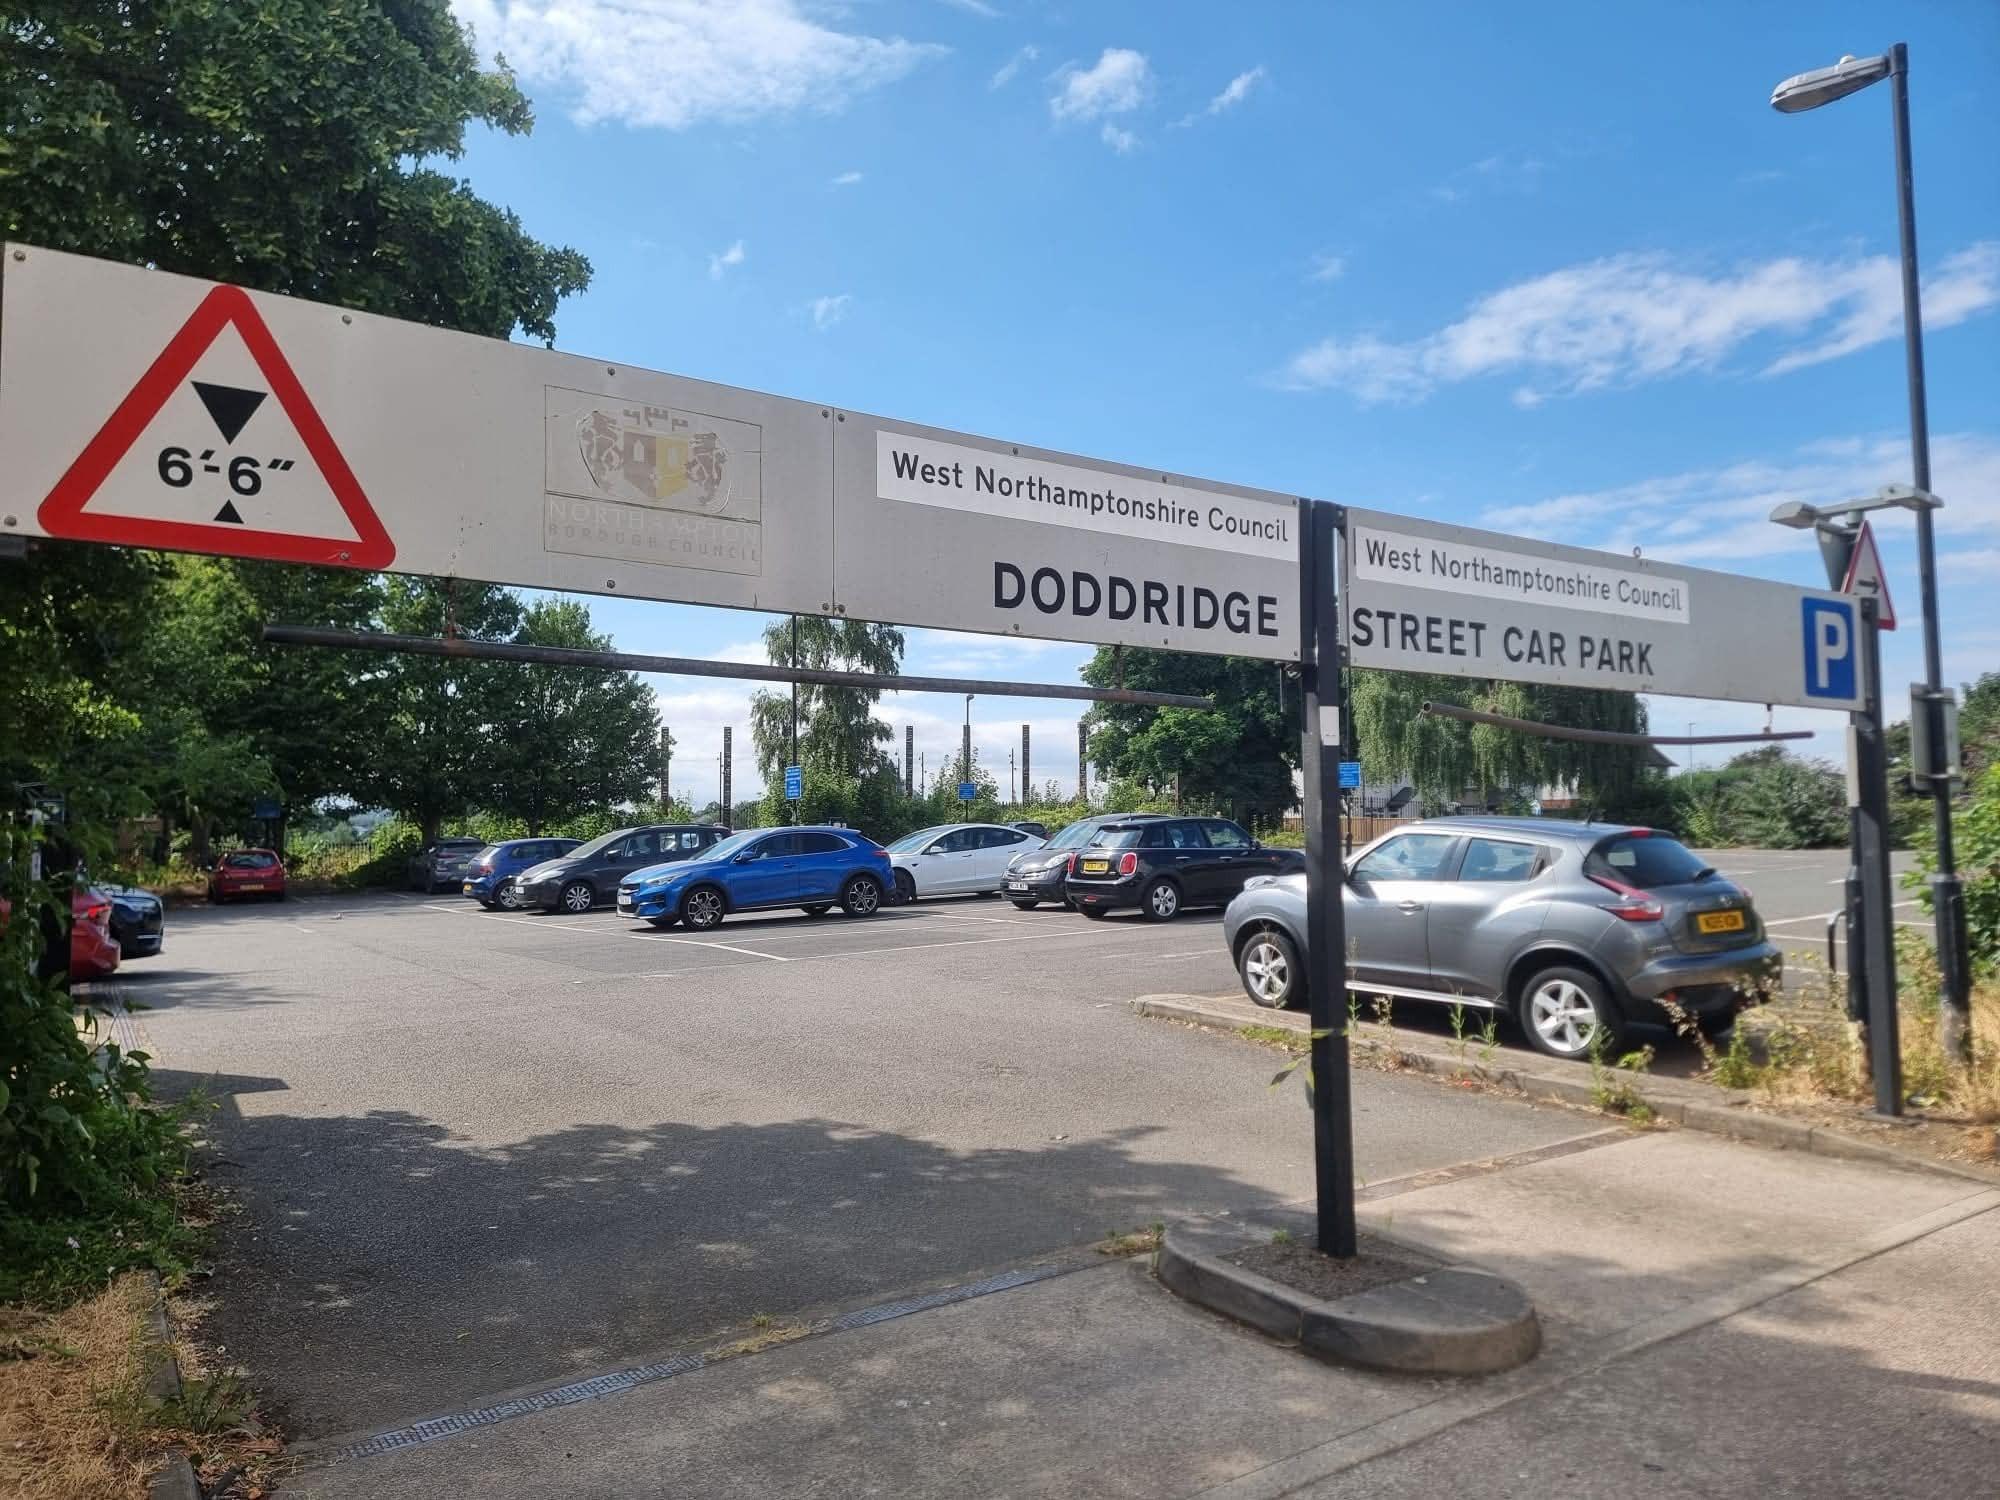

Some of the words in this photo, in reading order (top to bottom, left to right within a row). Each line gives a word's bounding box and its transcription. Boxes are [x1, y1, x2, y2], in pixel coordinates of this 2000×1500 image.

[892, 450, 963, 489] West
[975, 465, 1199, 527] Northamptonshire
[1208, 508, 1288, 542] Council
[669, 538, 760, 562] COUNCIL
[1366, 538, 1422, 573] West
[1431, 551, 1610, 600] Northamptonshire
[1618, 579, 1682, 611] Council
[994, 561, 1279, 637] DODDRIDGE
[1351, 607, 1487, 658] STREET
[1503, 626, 1566, 667] CAR
[1579, 635, 1654, 676] PARK
[1814, 609, 1849, 688] P
